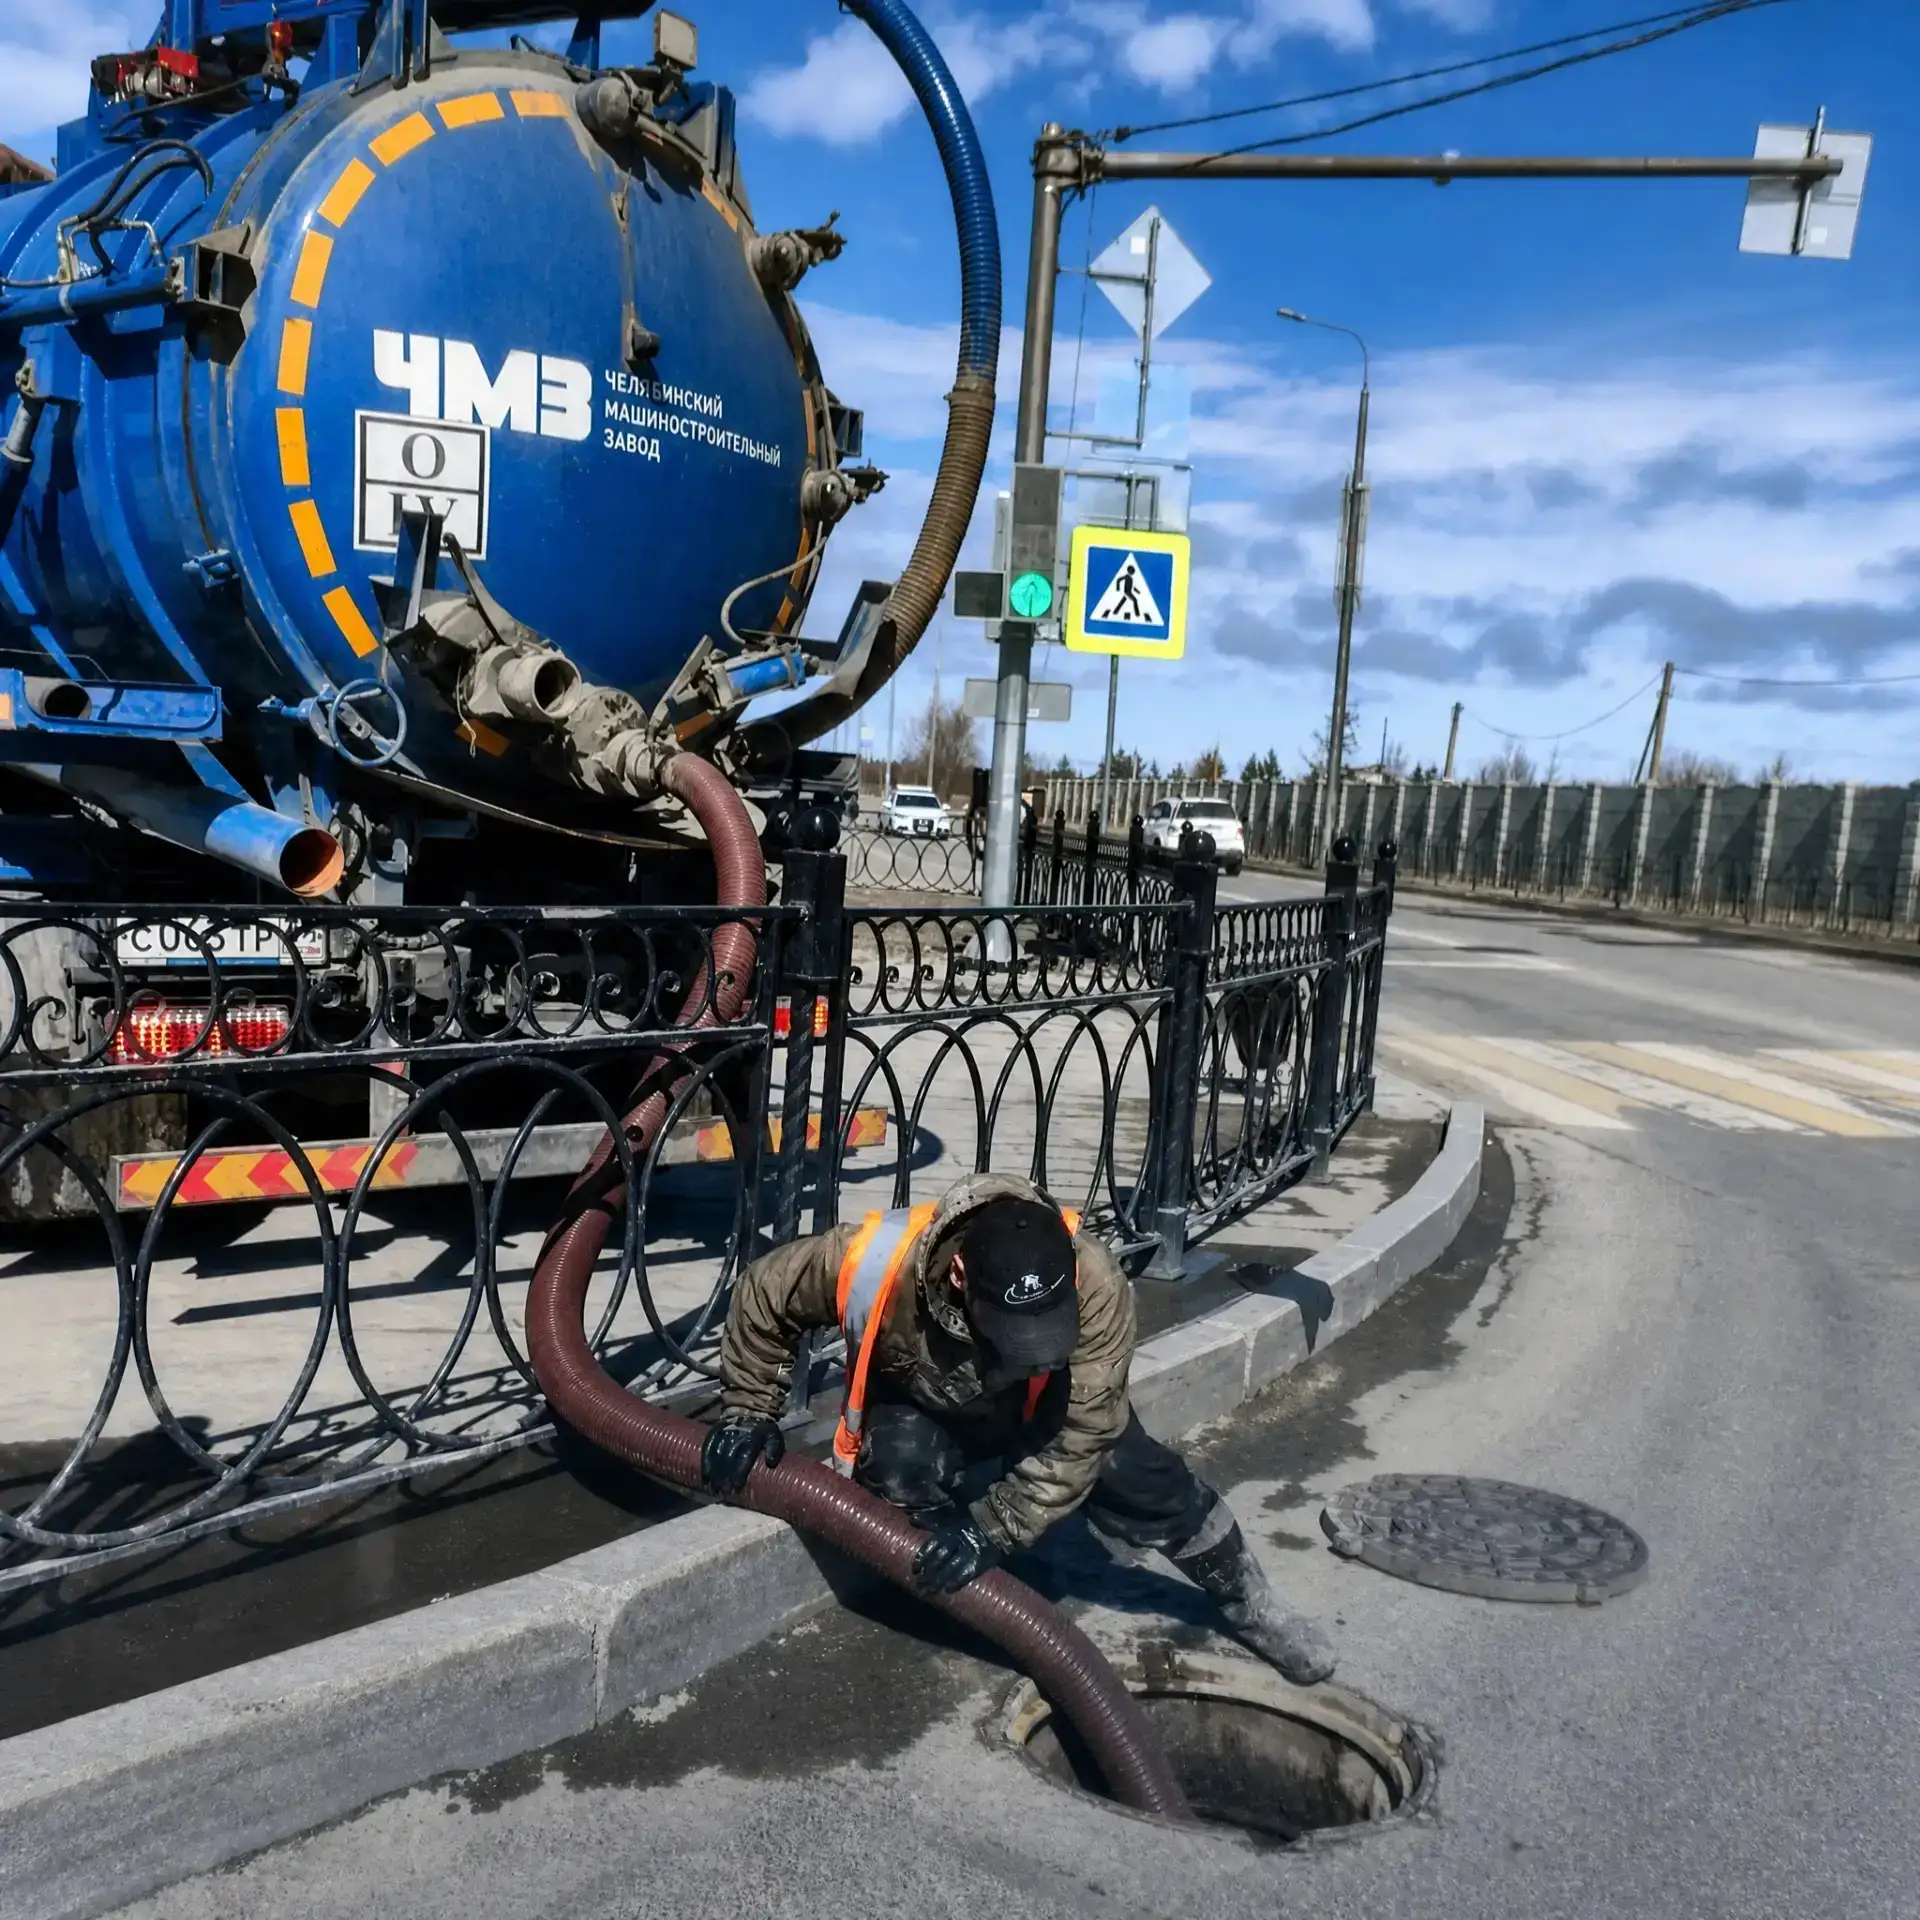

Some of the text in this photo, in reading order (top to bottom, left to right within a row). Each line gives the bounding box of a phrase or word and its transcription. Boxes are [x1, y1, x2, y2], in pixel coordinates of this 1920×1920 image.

[373, 328, 592, 441] ЧМЗ
[604, 369, 723, 419] ЧЕЛЯБИНСКИЙ
[603, 428, 661, 463] ЗАВОД
[604, 399, 781, 468] МАШИНОСТРОИТЕЛЬНЫЙ
